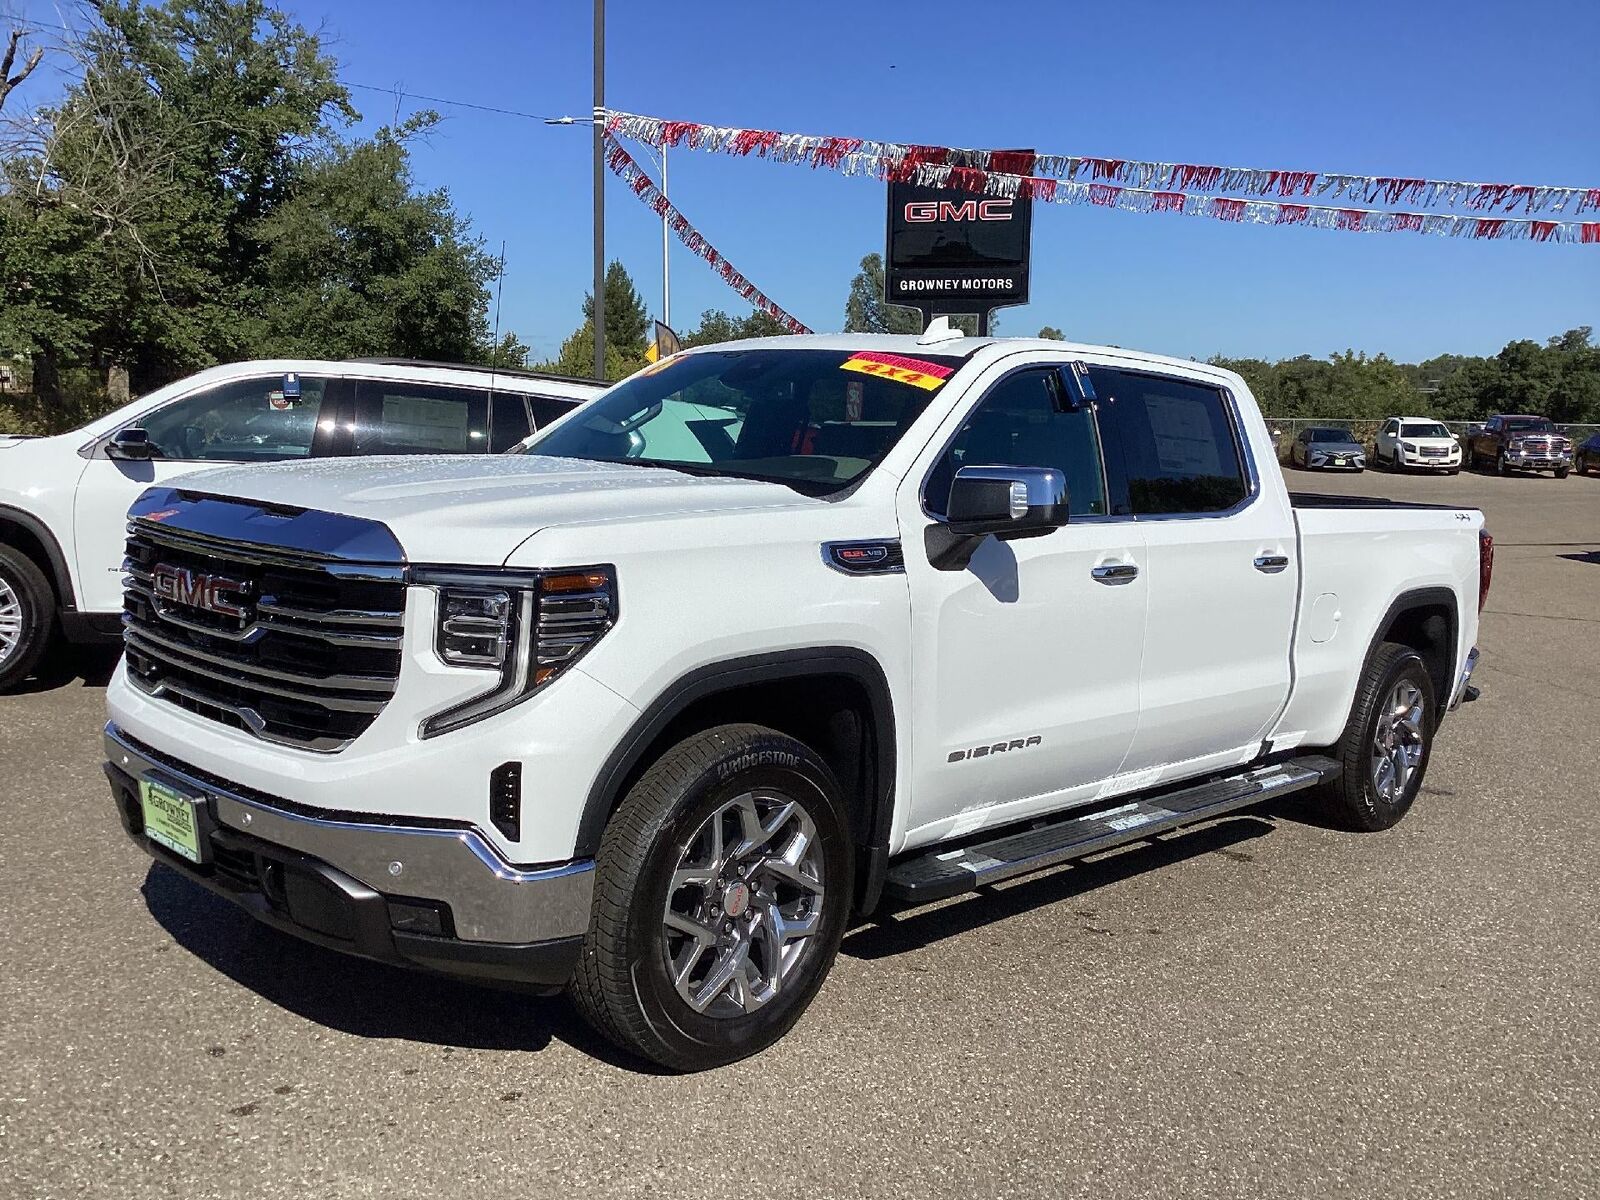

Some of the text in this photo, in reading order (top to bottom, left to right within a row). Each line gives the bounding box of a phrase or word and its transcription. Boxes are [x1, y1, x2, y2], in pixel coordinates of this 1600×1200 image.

[904, 200, 1013, 223] GMC
[899, 279, 1013, 291] GROWNEY MOTORS
[152, 562, 250, 618] GMC
[947, 735, 1042, 763] SIERRA
